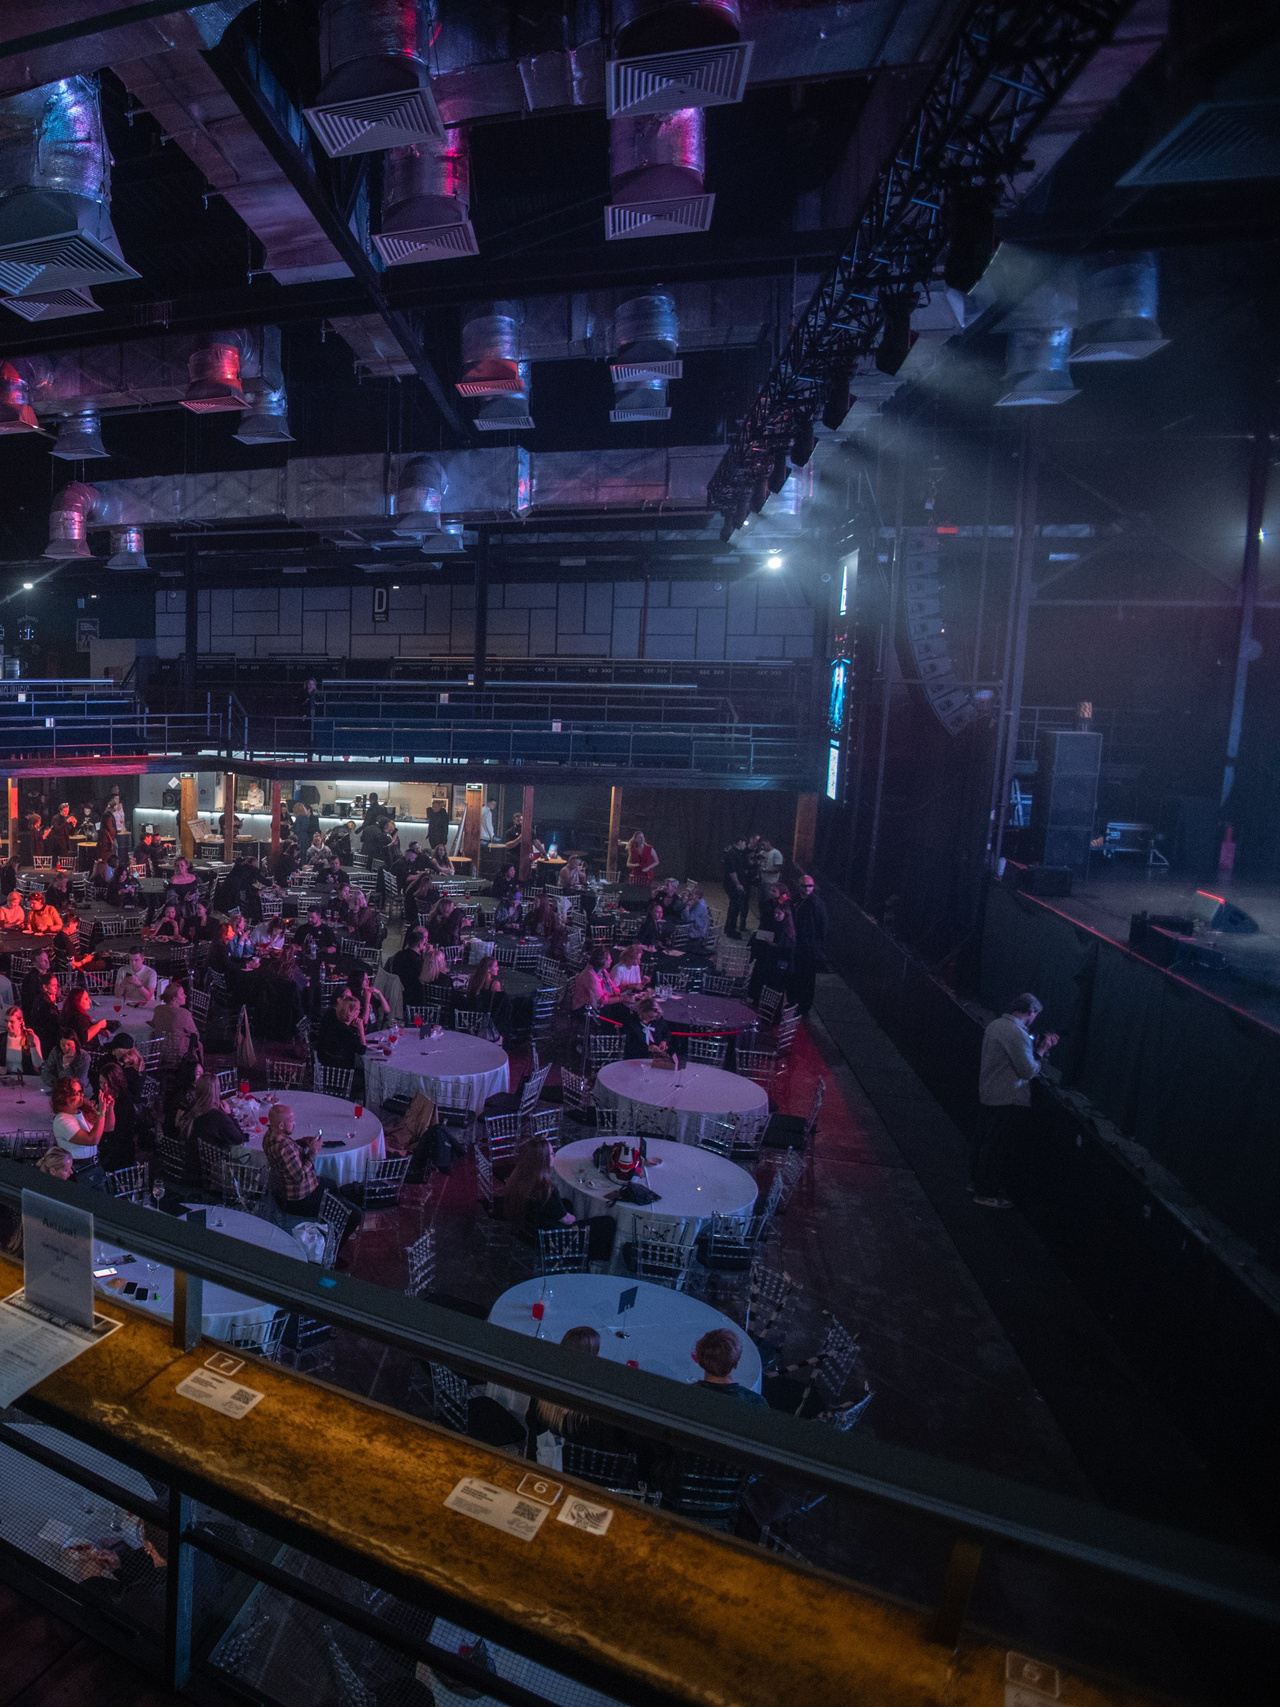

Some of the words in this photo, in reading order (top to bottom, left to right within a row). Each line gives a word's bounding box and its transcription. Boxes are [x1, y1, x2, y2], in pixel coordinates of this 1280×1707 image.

[374, 588, 387, 613] D
[42, 1217, 78, 1238] Акция!
[219, 1357, 235, 1368] 7
[533, 1481, 549, 1494] 6
